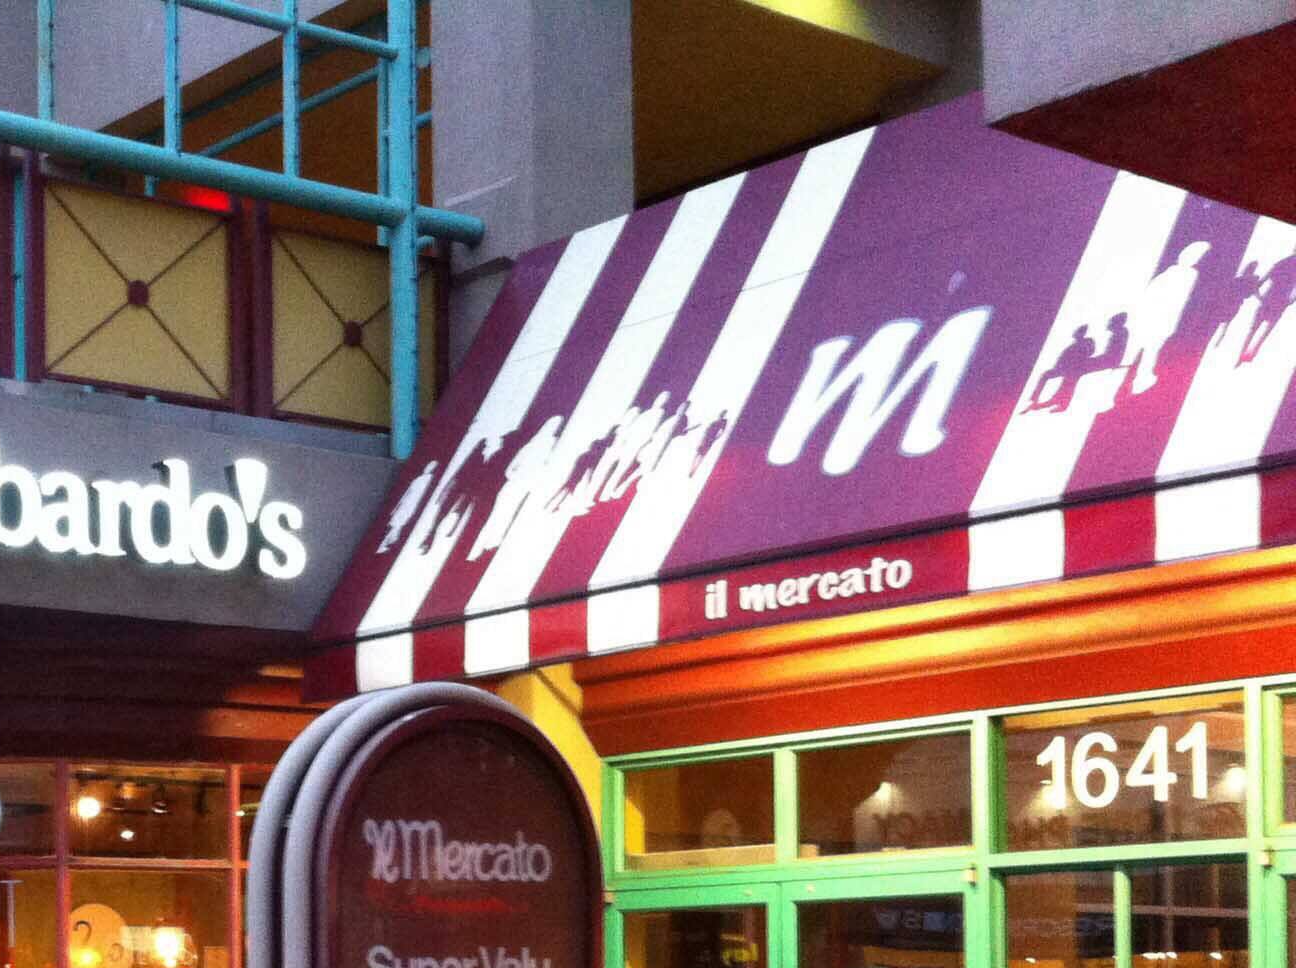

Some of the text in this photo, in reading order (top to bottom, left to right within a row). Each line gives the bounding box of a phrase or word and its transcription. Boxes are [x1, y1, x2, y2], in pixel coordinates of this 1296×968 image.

[705, 557, 913, 619] il mercato
[1037, 721, 1208, 810] 1641
[399, 819, 553, 882] Mercato
